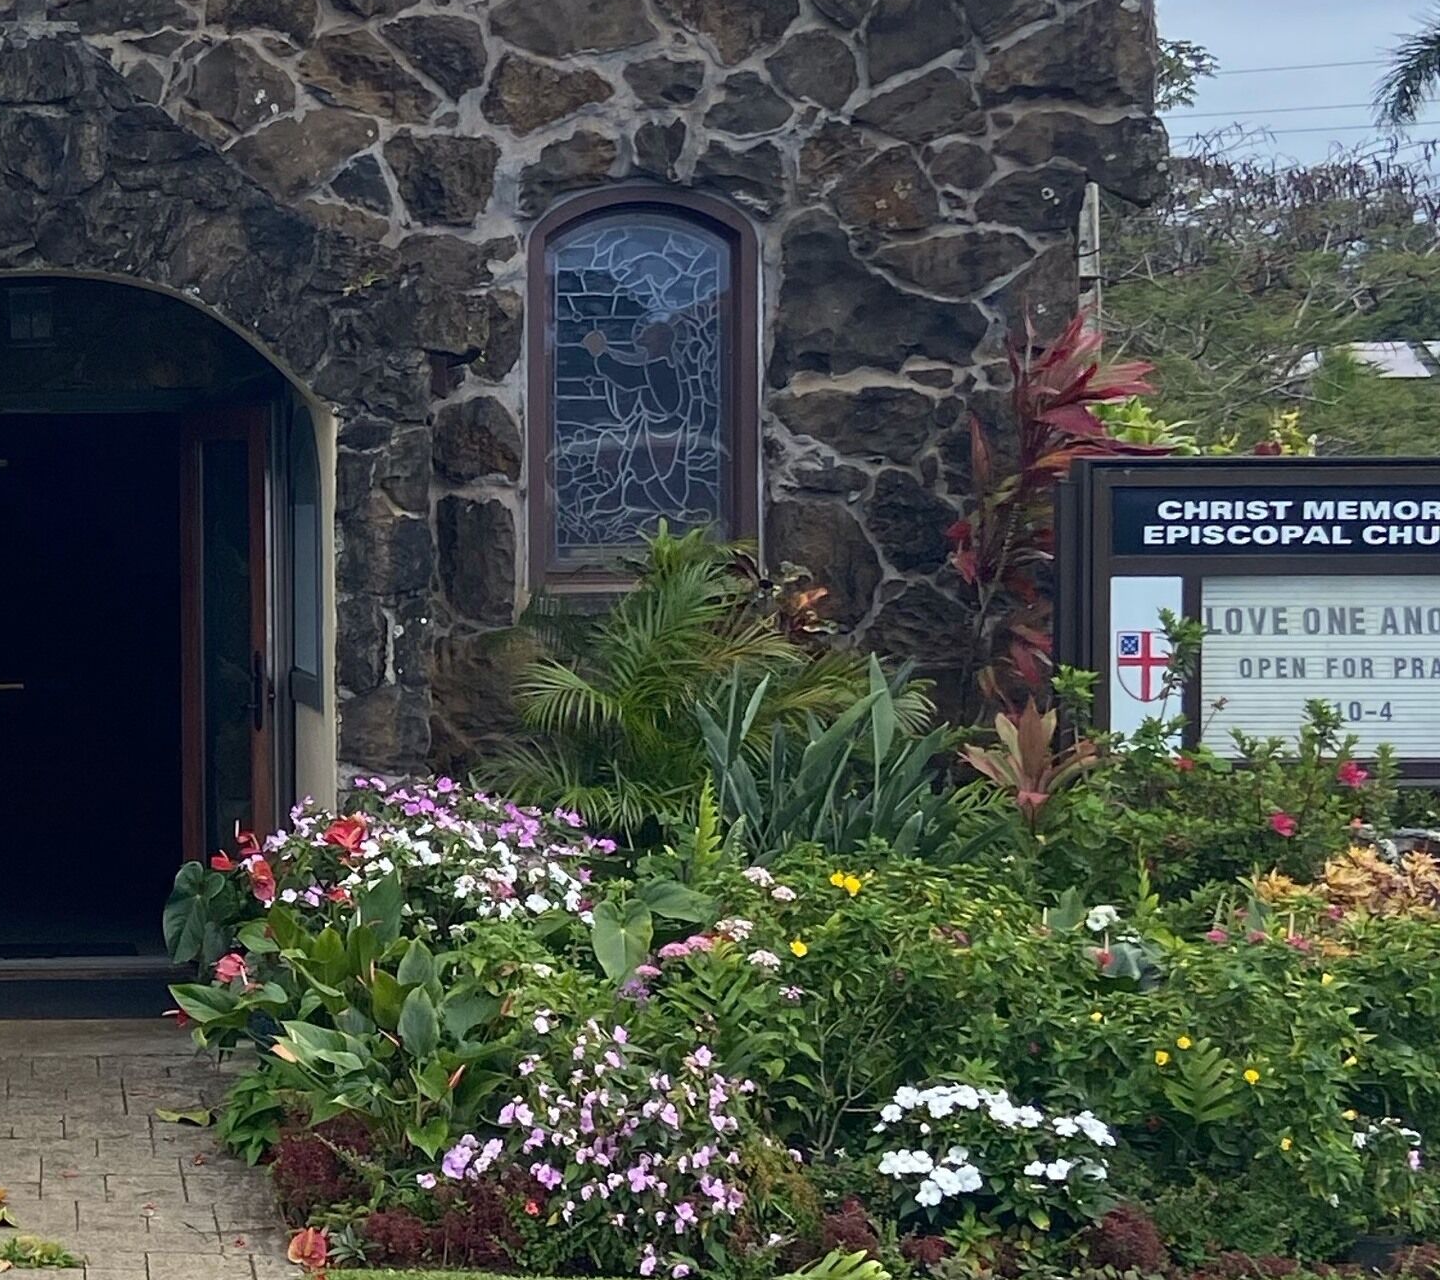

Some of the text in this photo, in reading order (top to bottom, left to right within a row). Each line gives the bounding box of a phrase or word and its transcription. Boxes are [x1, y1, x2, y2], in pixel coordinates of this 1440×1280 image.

[1157, 500, 1440, 520] CHRIST MEMOR
[1143, 525, 1440, 545] EPISCOPAL CHU
[1206, 607, 1440, 635] LOVE ONE ANO
[1239, 657, 1440, 679] OPEN FOR PRA
